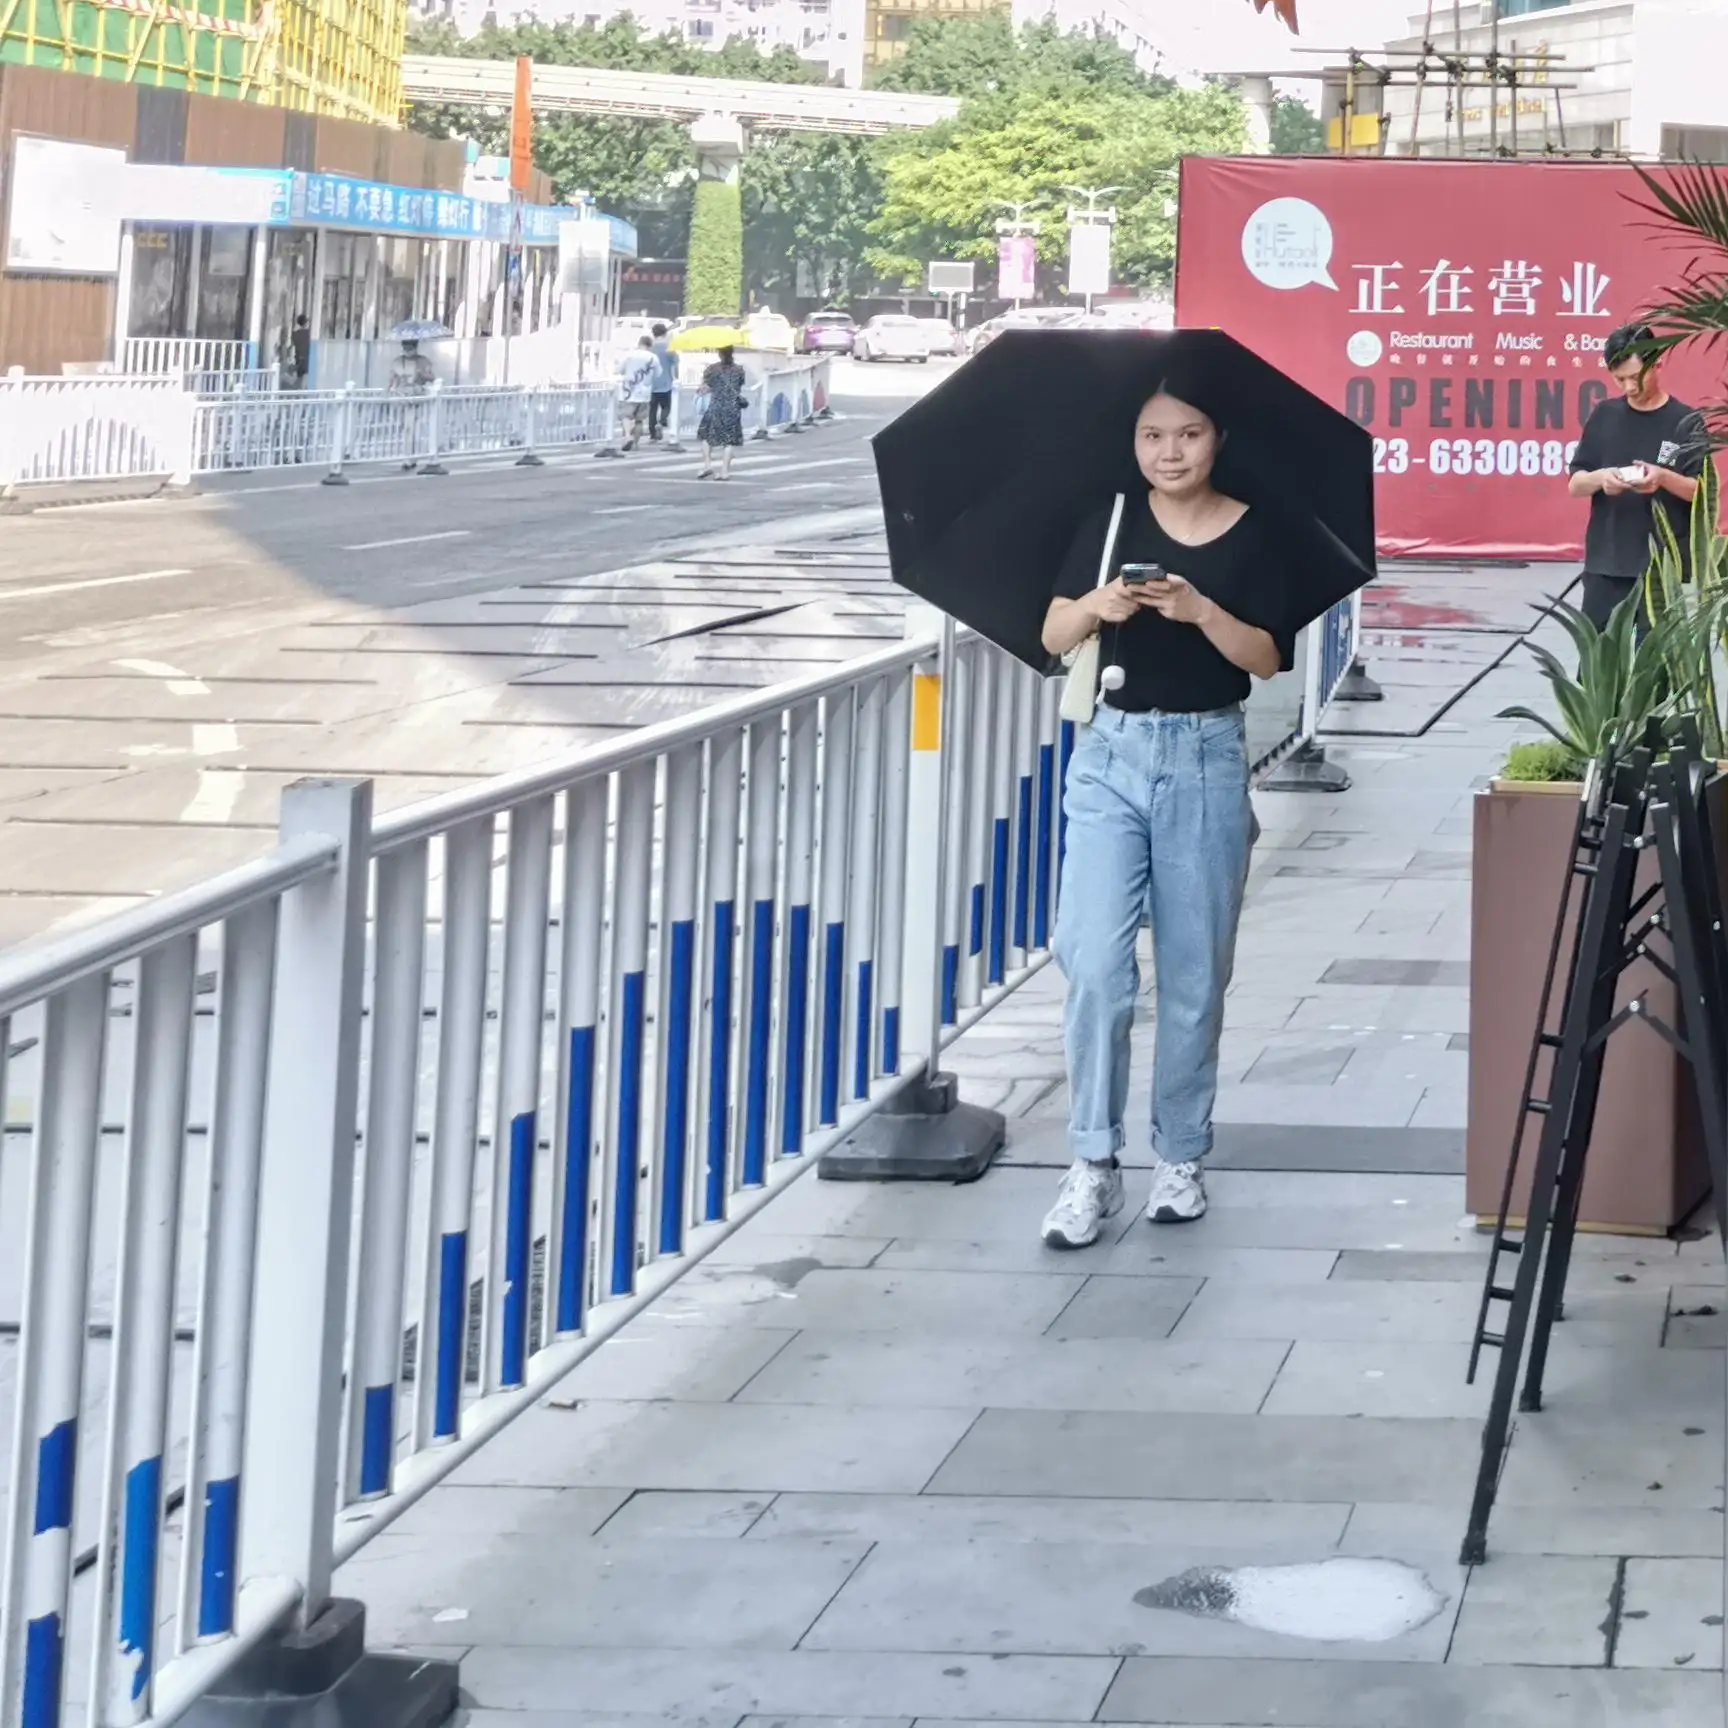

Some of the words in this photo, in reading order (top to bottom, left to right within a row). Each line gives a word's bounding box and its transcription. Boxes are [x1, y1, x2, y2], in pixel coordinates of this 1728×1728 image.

[1349, 259, 1611, 317] 正在营业
[1390, 331, 1474, 349] Restaurant
[1496, 332, 1543, 351] Music
